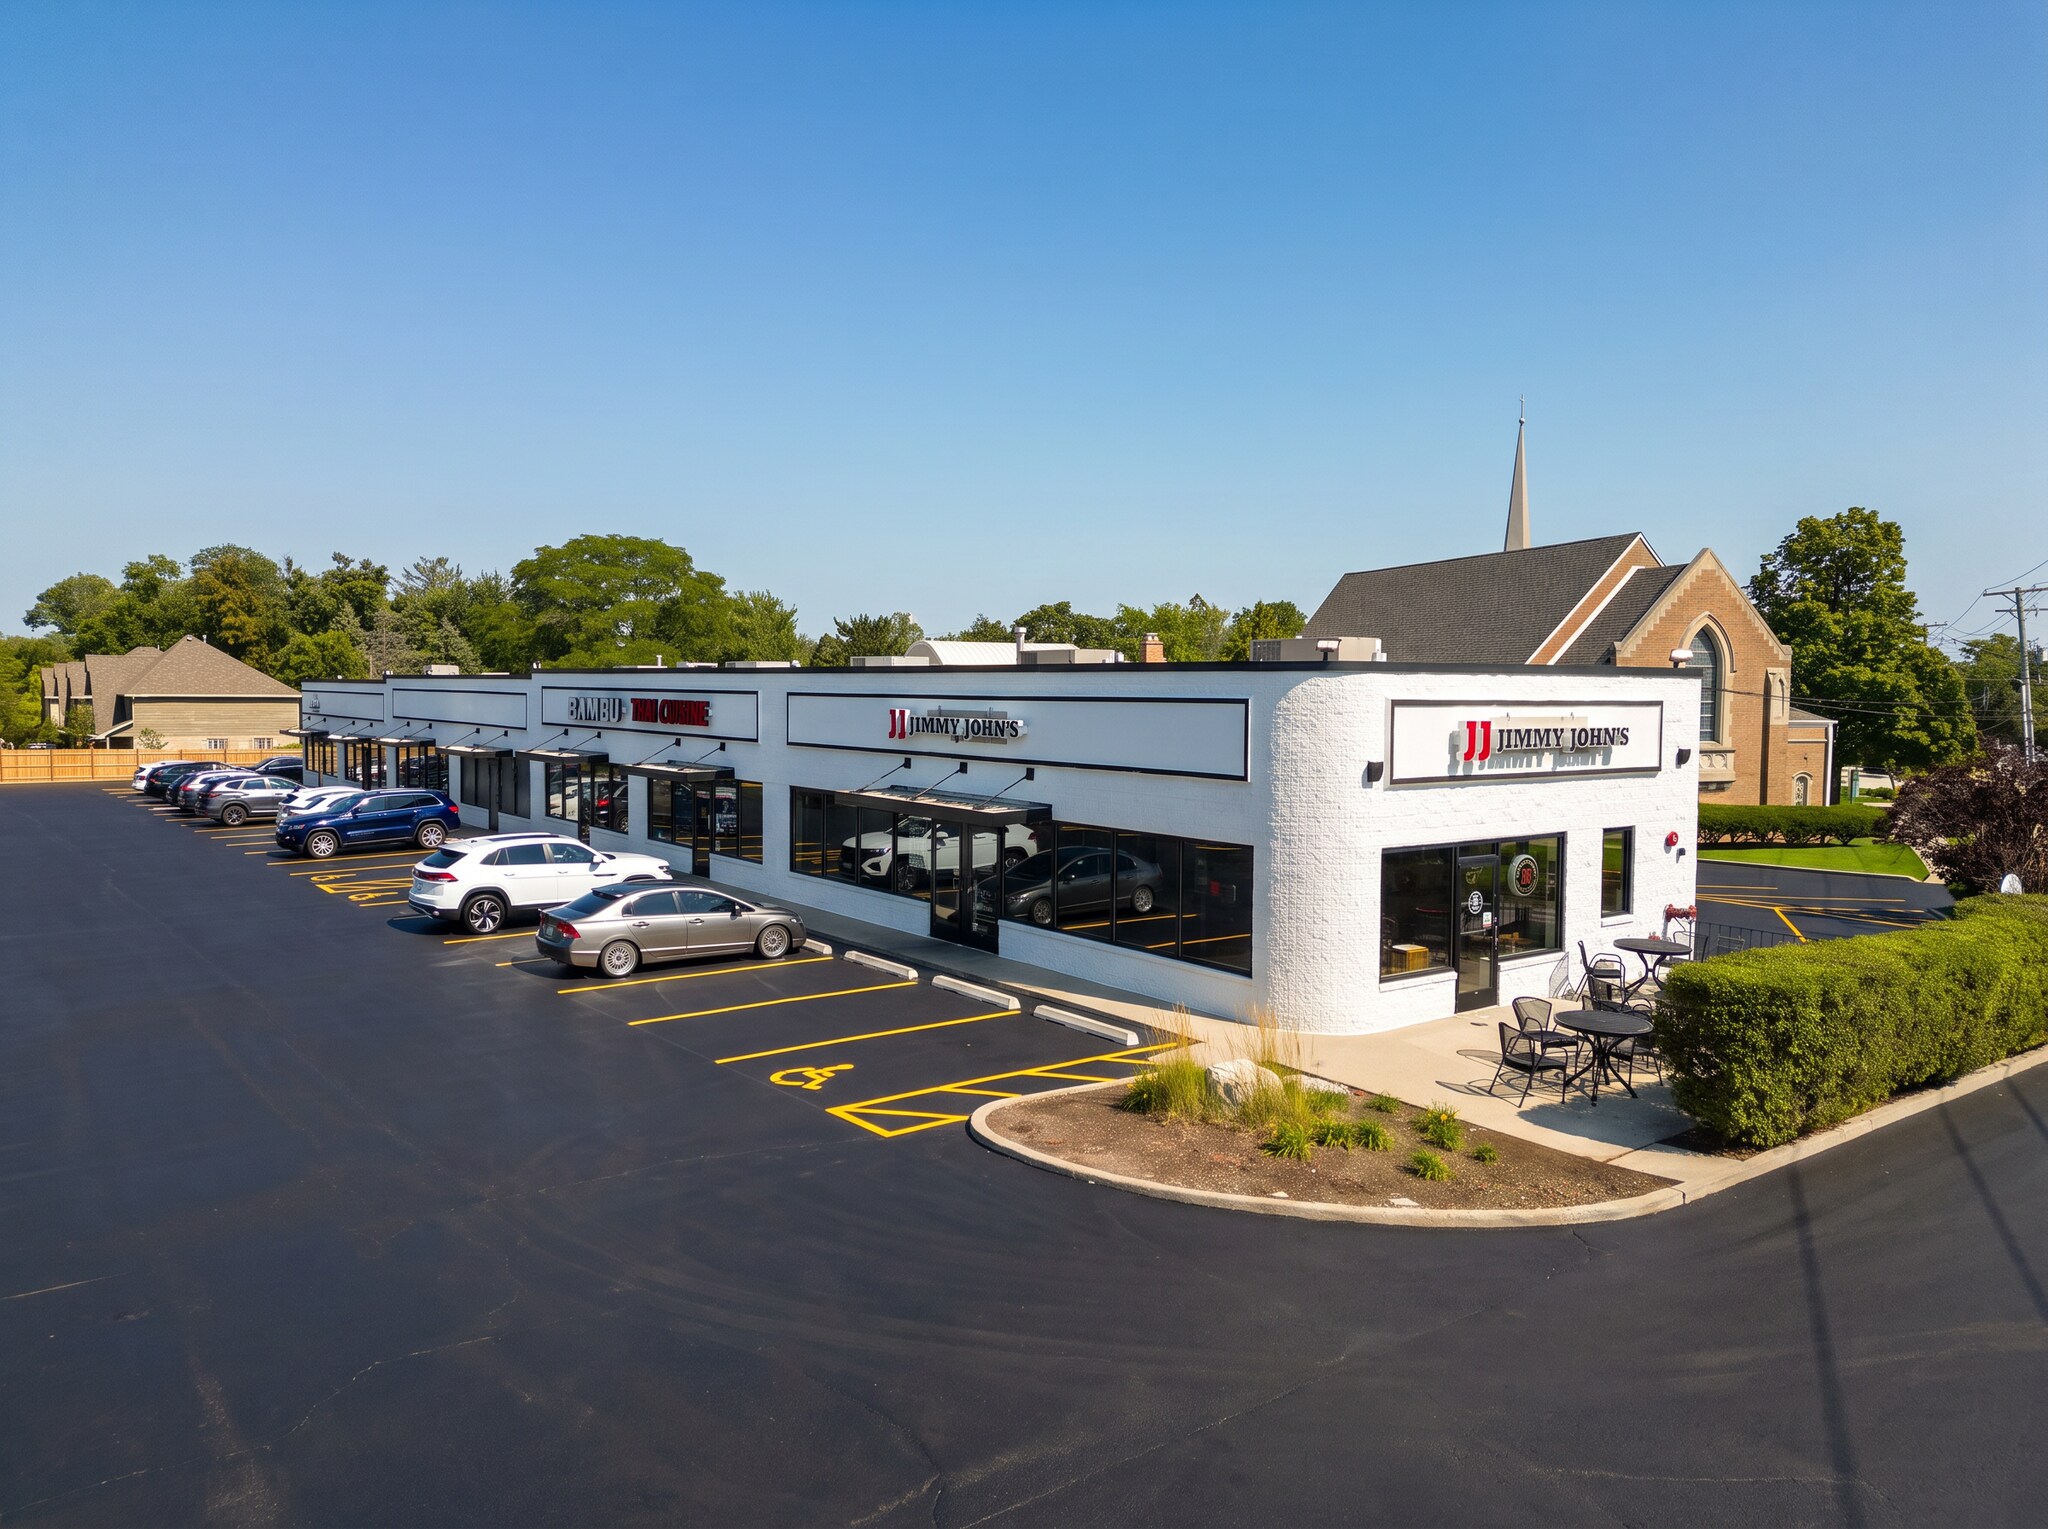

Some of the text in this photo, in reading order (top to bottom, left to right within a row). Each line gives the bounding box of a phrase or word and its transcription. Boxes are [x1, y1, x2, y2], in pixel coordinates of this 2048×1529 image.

[568, 697, 710, 726] BAMBU THAI CUISINE
[888, 709, 1019, 739] JJ JIMMY JOHN'S
[1463, 721, 1629, 761] JJ JIMMY JOHN'S
